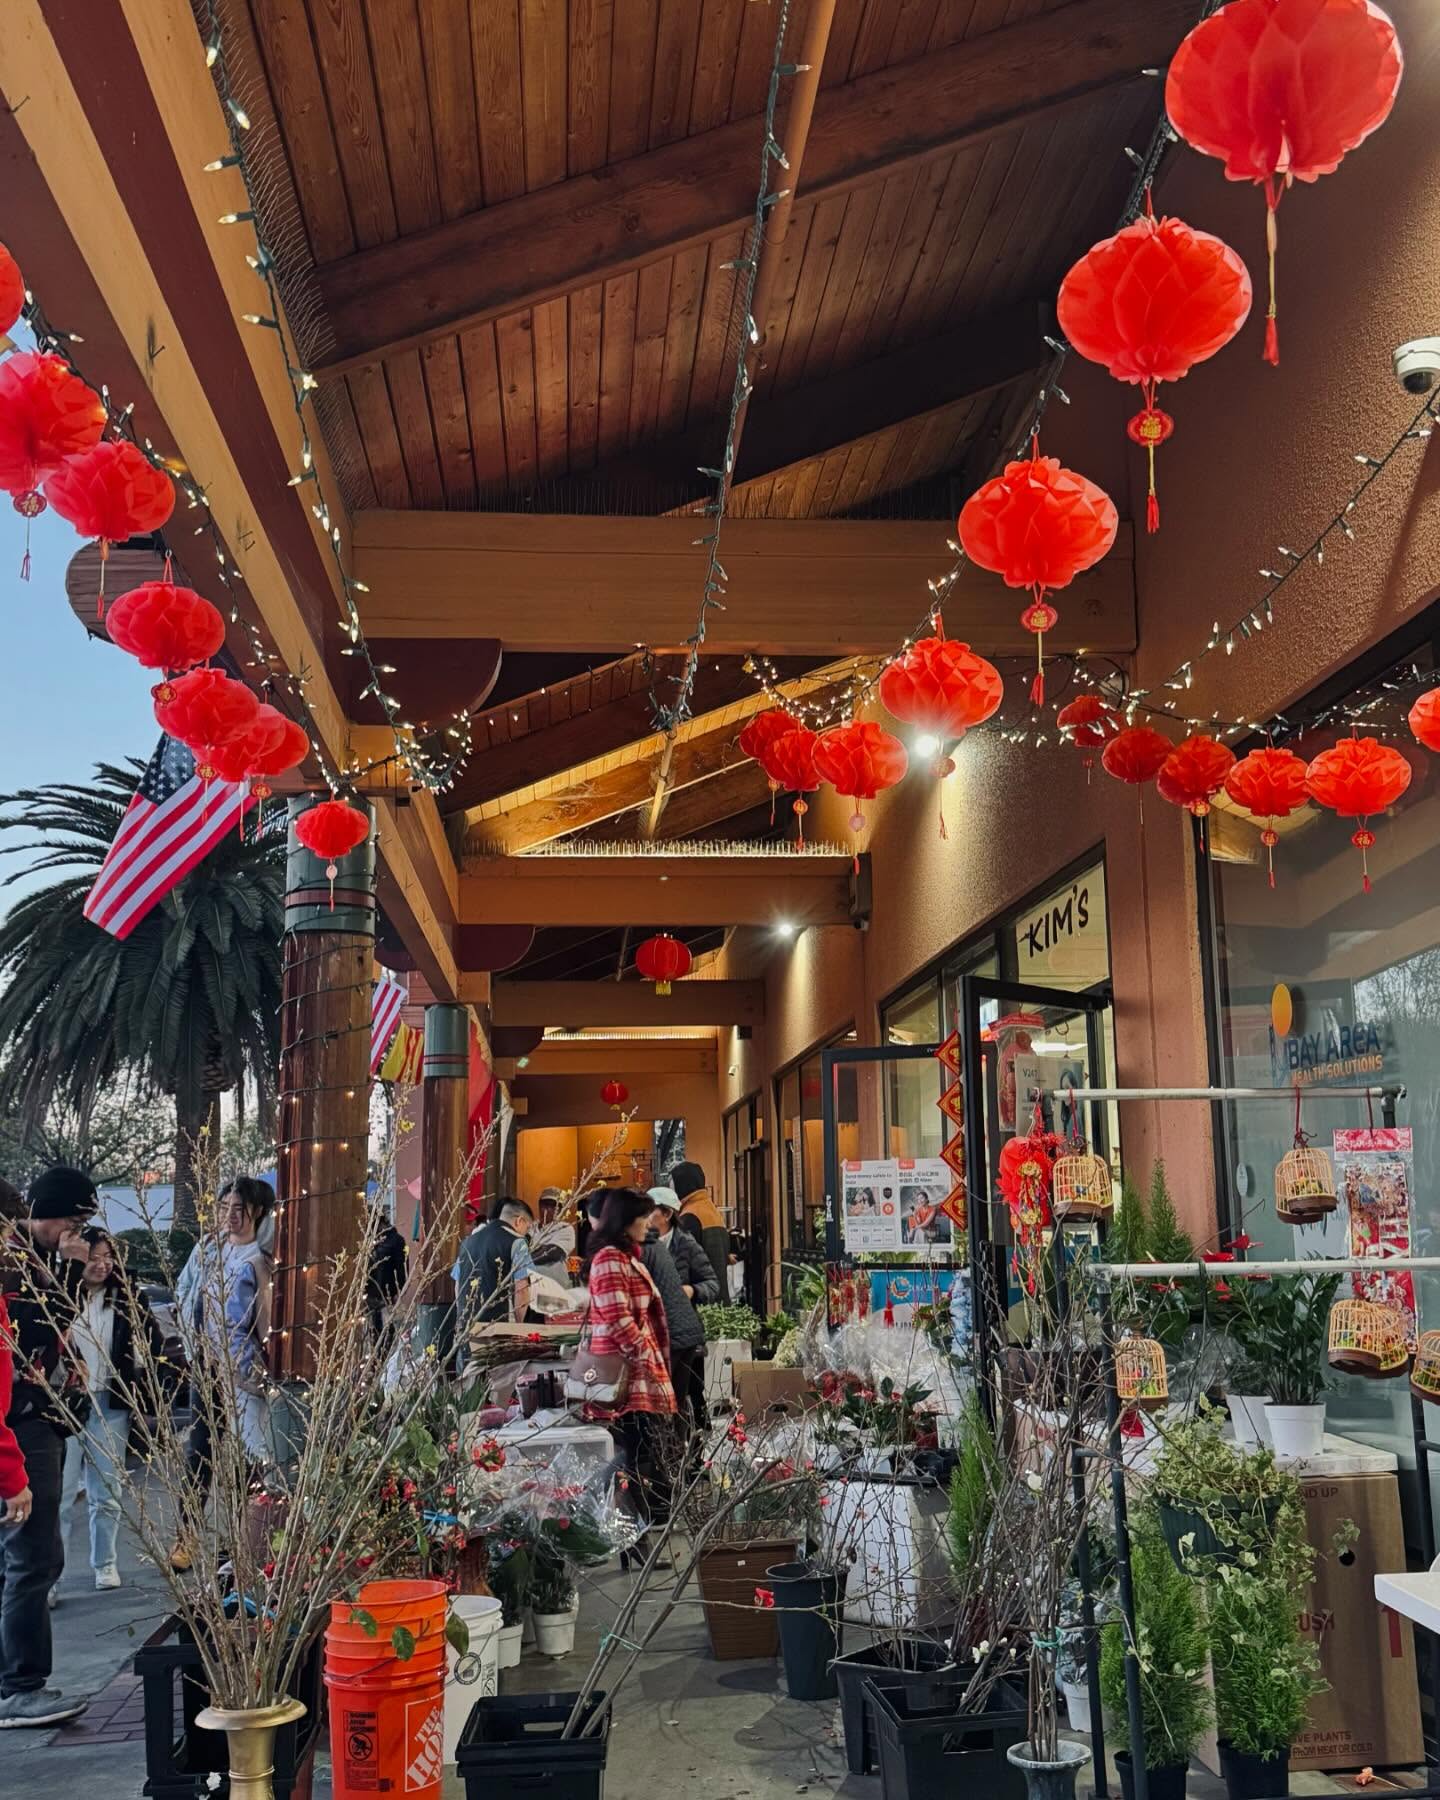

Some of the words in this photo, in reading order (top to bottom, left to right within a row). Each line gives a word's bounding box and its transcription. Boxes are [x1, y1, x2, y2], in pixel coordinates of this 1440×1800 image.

[1028, 884, 1089, 958] KIM'S
[1288, 1031, 1321, 1070] BAY
[1326, 1020, 1381, 1062] AREA
[1326, 1055, 1383, 1079] SOLUTIONS
[1320, 1487, 1338, 1498] UP
[1299, 1611, 1335, 1632] USH
[414, 1705, 441, 1744] THE
[1313, 1730, 1352, 1742] PLANTS
[1318, 1744, 1338, 1755] HEAT
